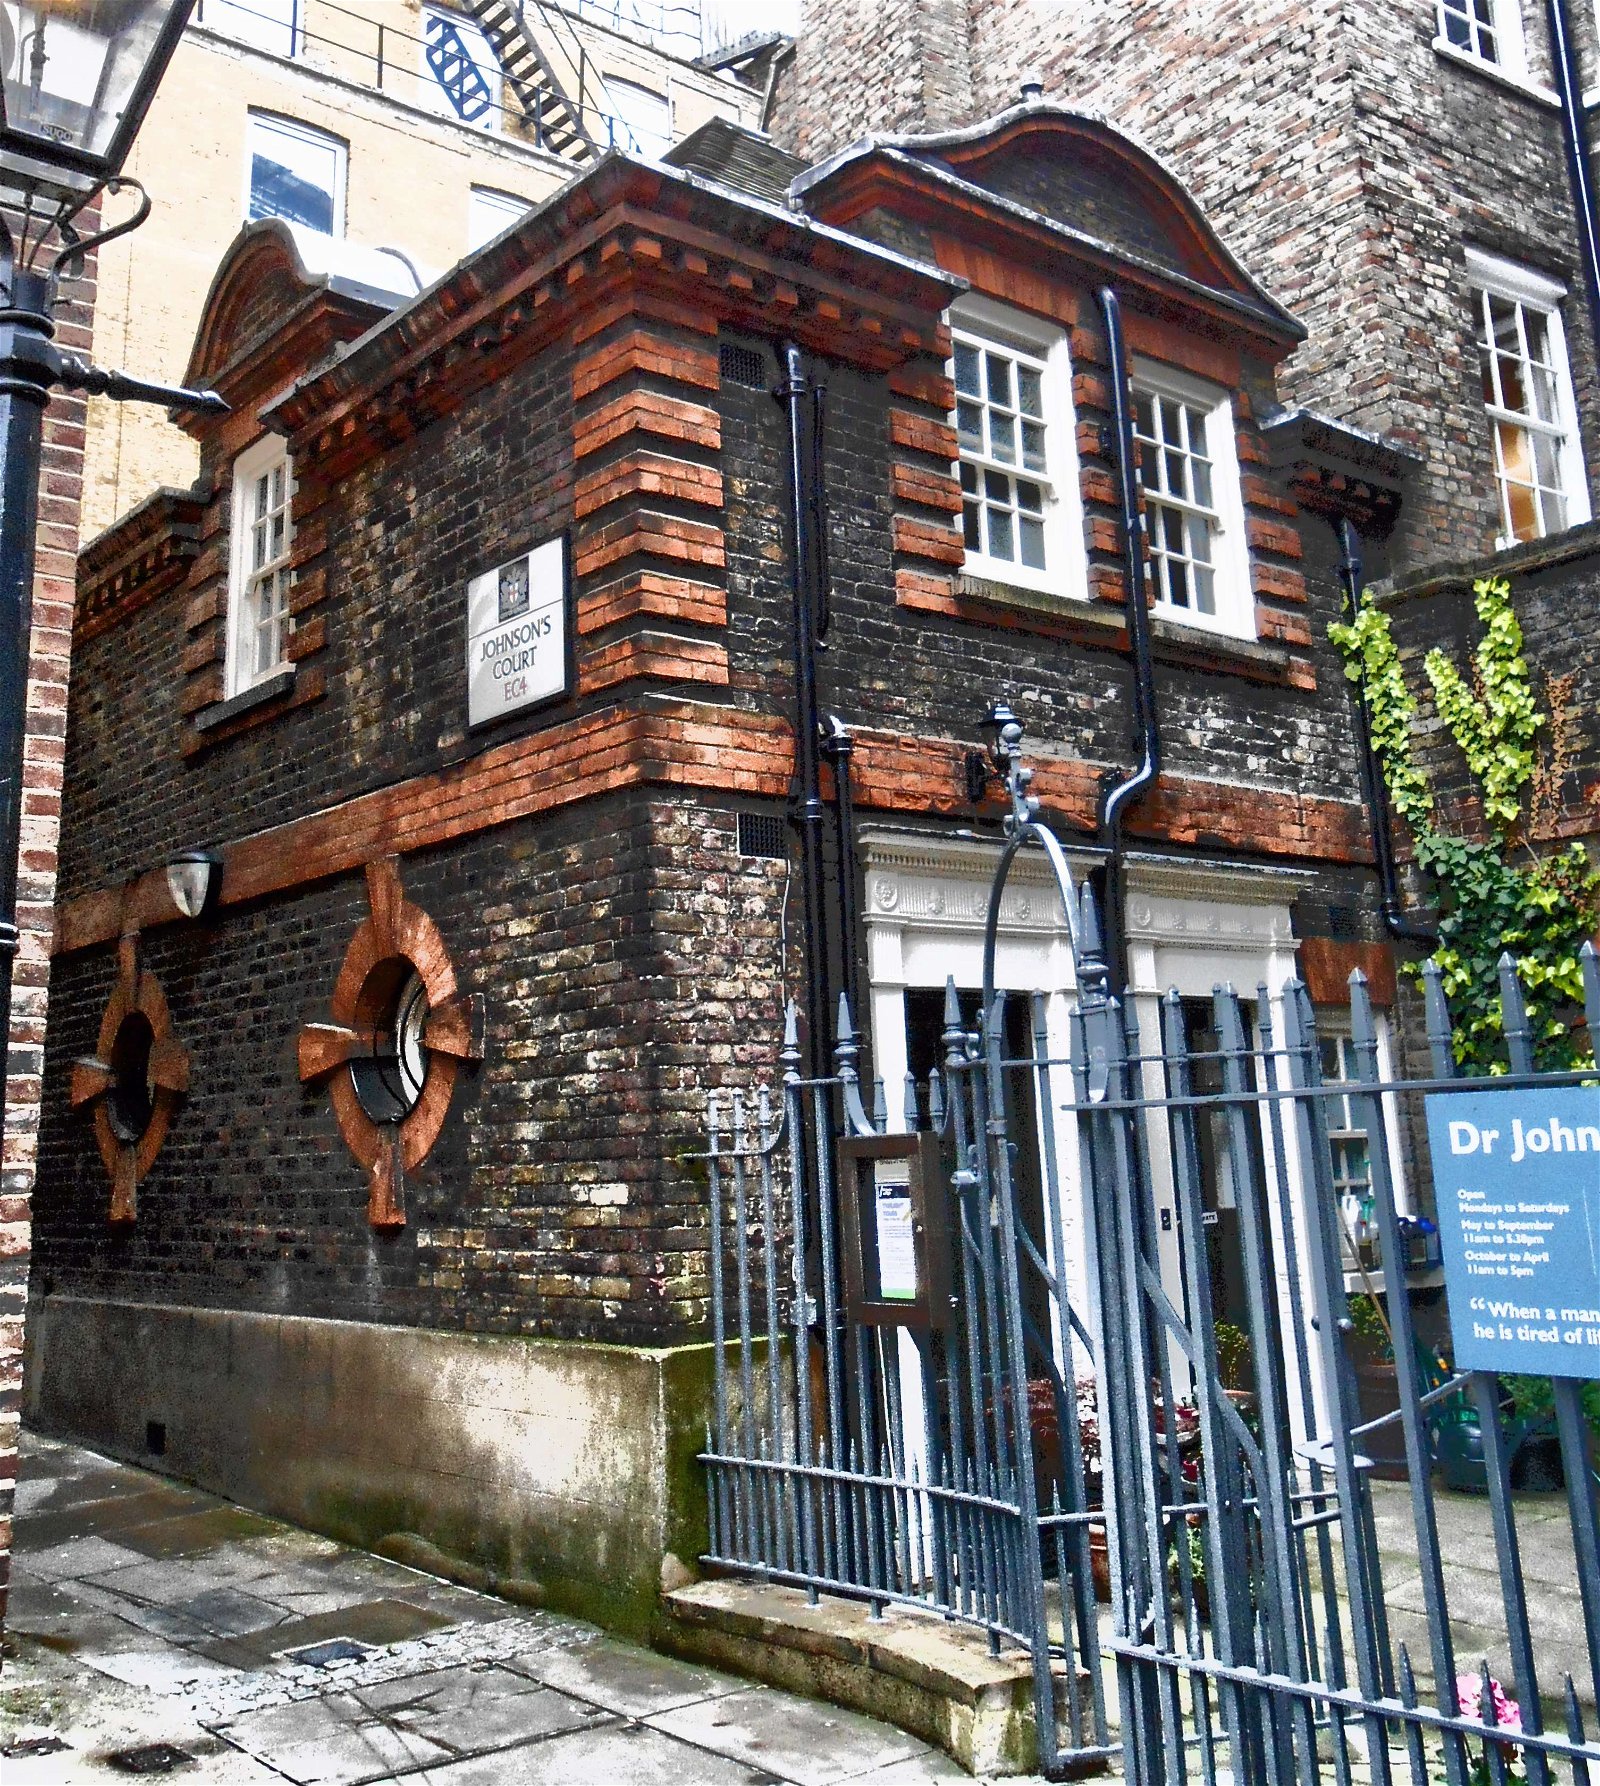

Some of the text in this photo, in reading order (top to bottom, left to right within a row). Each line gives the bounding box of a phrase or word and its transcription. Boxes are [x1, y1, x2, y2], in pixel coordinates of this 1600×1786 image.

[480, 615, 551, 662] JOHNSON'S
[492, 646, 537, 680] COURT
[504, 676, 527, 701] EC4
[1449, 1117, 1600, 1162] Dr John
[1458, 1189, 1485, 1201] Open
[1459, 1203, 1569, 1215] Mondays to Saturdays
[1461, 1220, 1554, 1232] May to September
[1493, 1235, 1504, 1244] to
[1465, 1250, 1549, 1264] October to April
[1496, 1266, 1508, 1275] to
[1510, 1264, 1534, 1278] 5pm
[1545, 1308, 1556, 1320] a
[1561, 1309, 1600, 1322] man
[1473, 1322, 1495, 1339] he
[1499, 1323, 1513, 1340] is
[1517, 1325, 1559, 1343] tired
[1563, 1328, 1582, 1344] of
